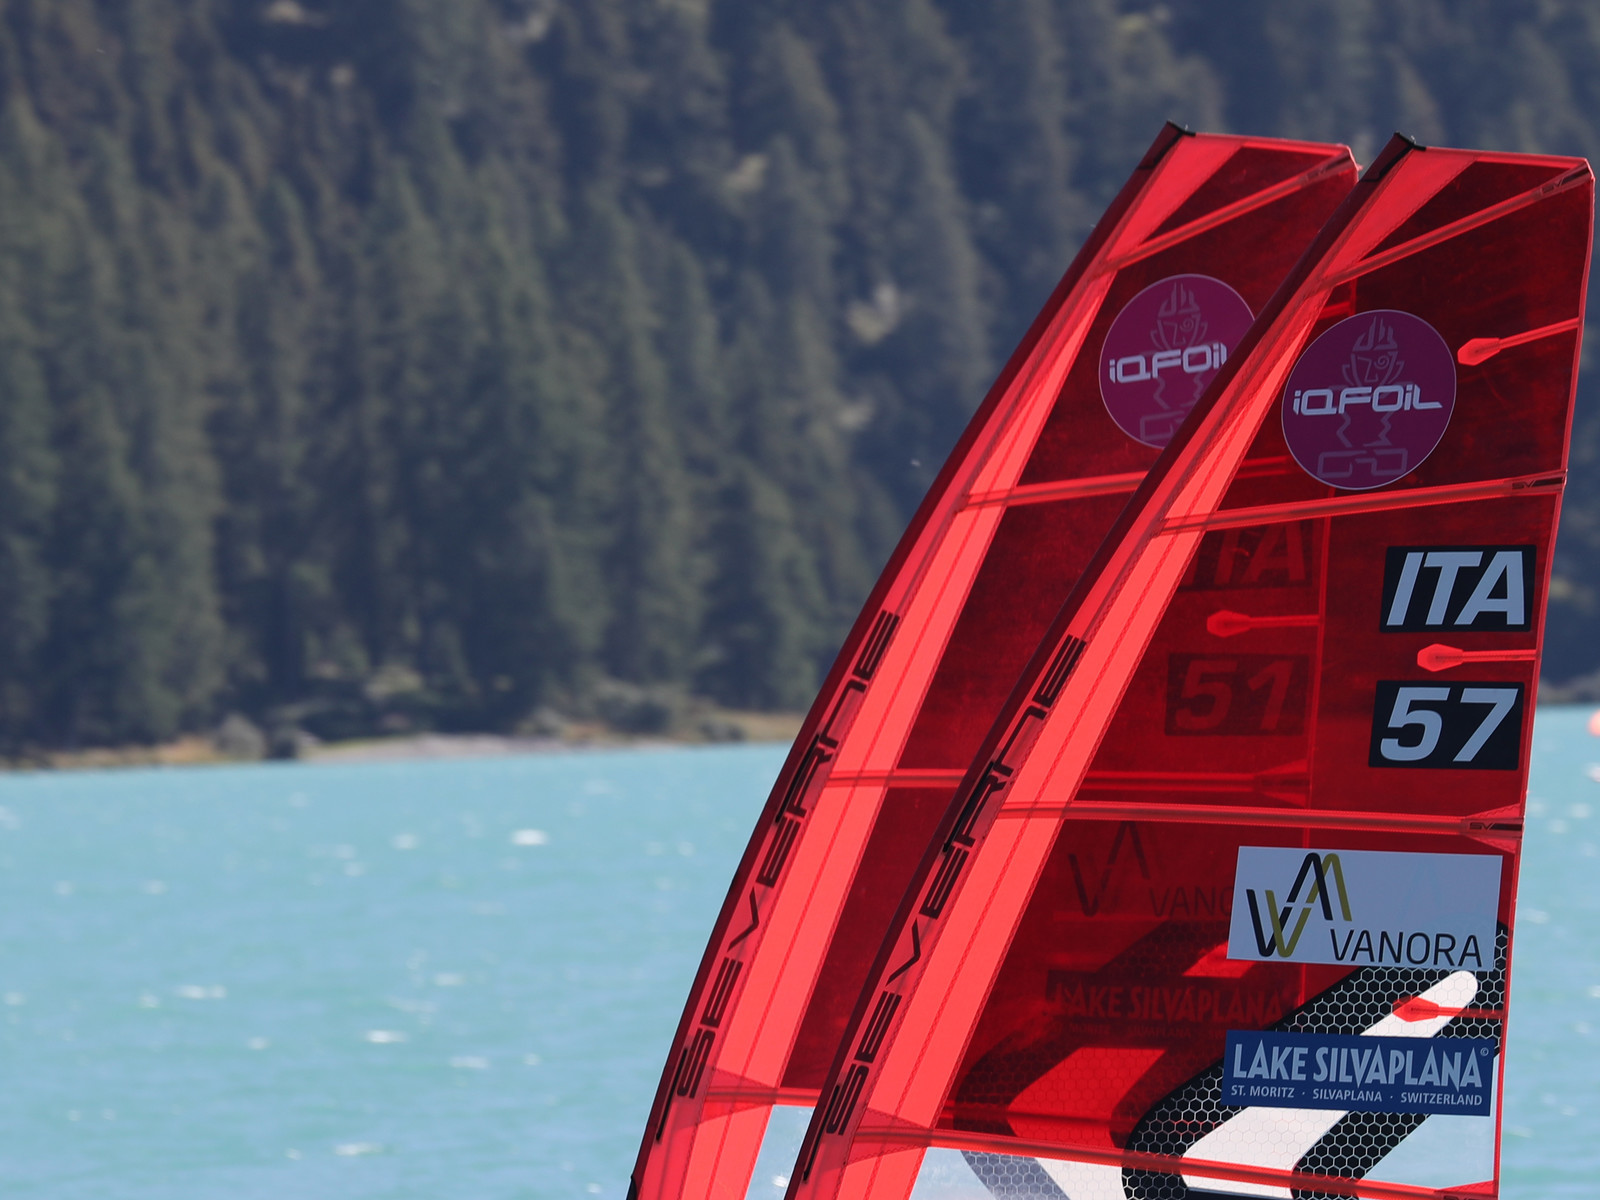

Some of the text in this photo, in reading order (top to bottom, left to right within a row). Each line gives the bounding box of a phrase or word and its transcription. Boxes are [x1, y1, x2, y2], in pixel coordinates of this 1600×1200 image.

[1109, 342, 1227, 384] iQFOi
[1182, 522, 1306, 586] TA
[1386, 550, 1525, 626] ITA
[1175, 659, 1294, 731] 51
[1379, 687, 1519, 762] 57
[677, 610, 900, 1099] SEVERNE
[826, 633, 1087, 1136] SEVERNE
[1330, 929, 1483, 968] VANORA
[1233, 1039, 1308, 1081] LAKE
[1231, 1085, 1483, 1106] ST. MORITZ SILVAPLANA SWITZERLAND
